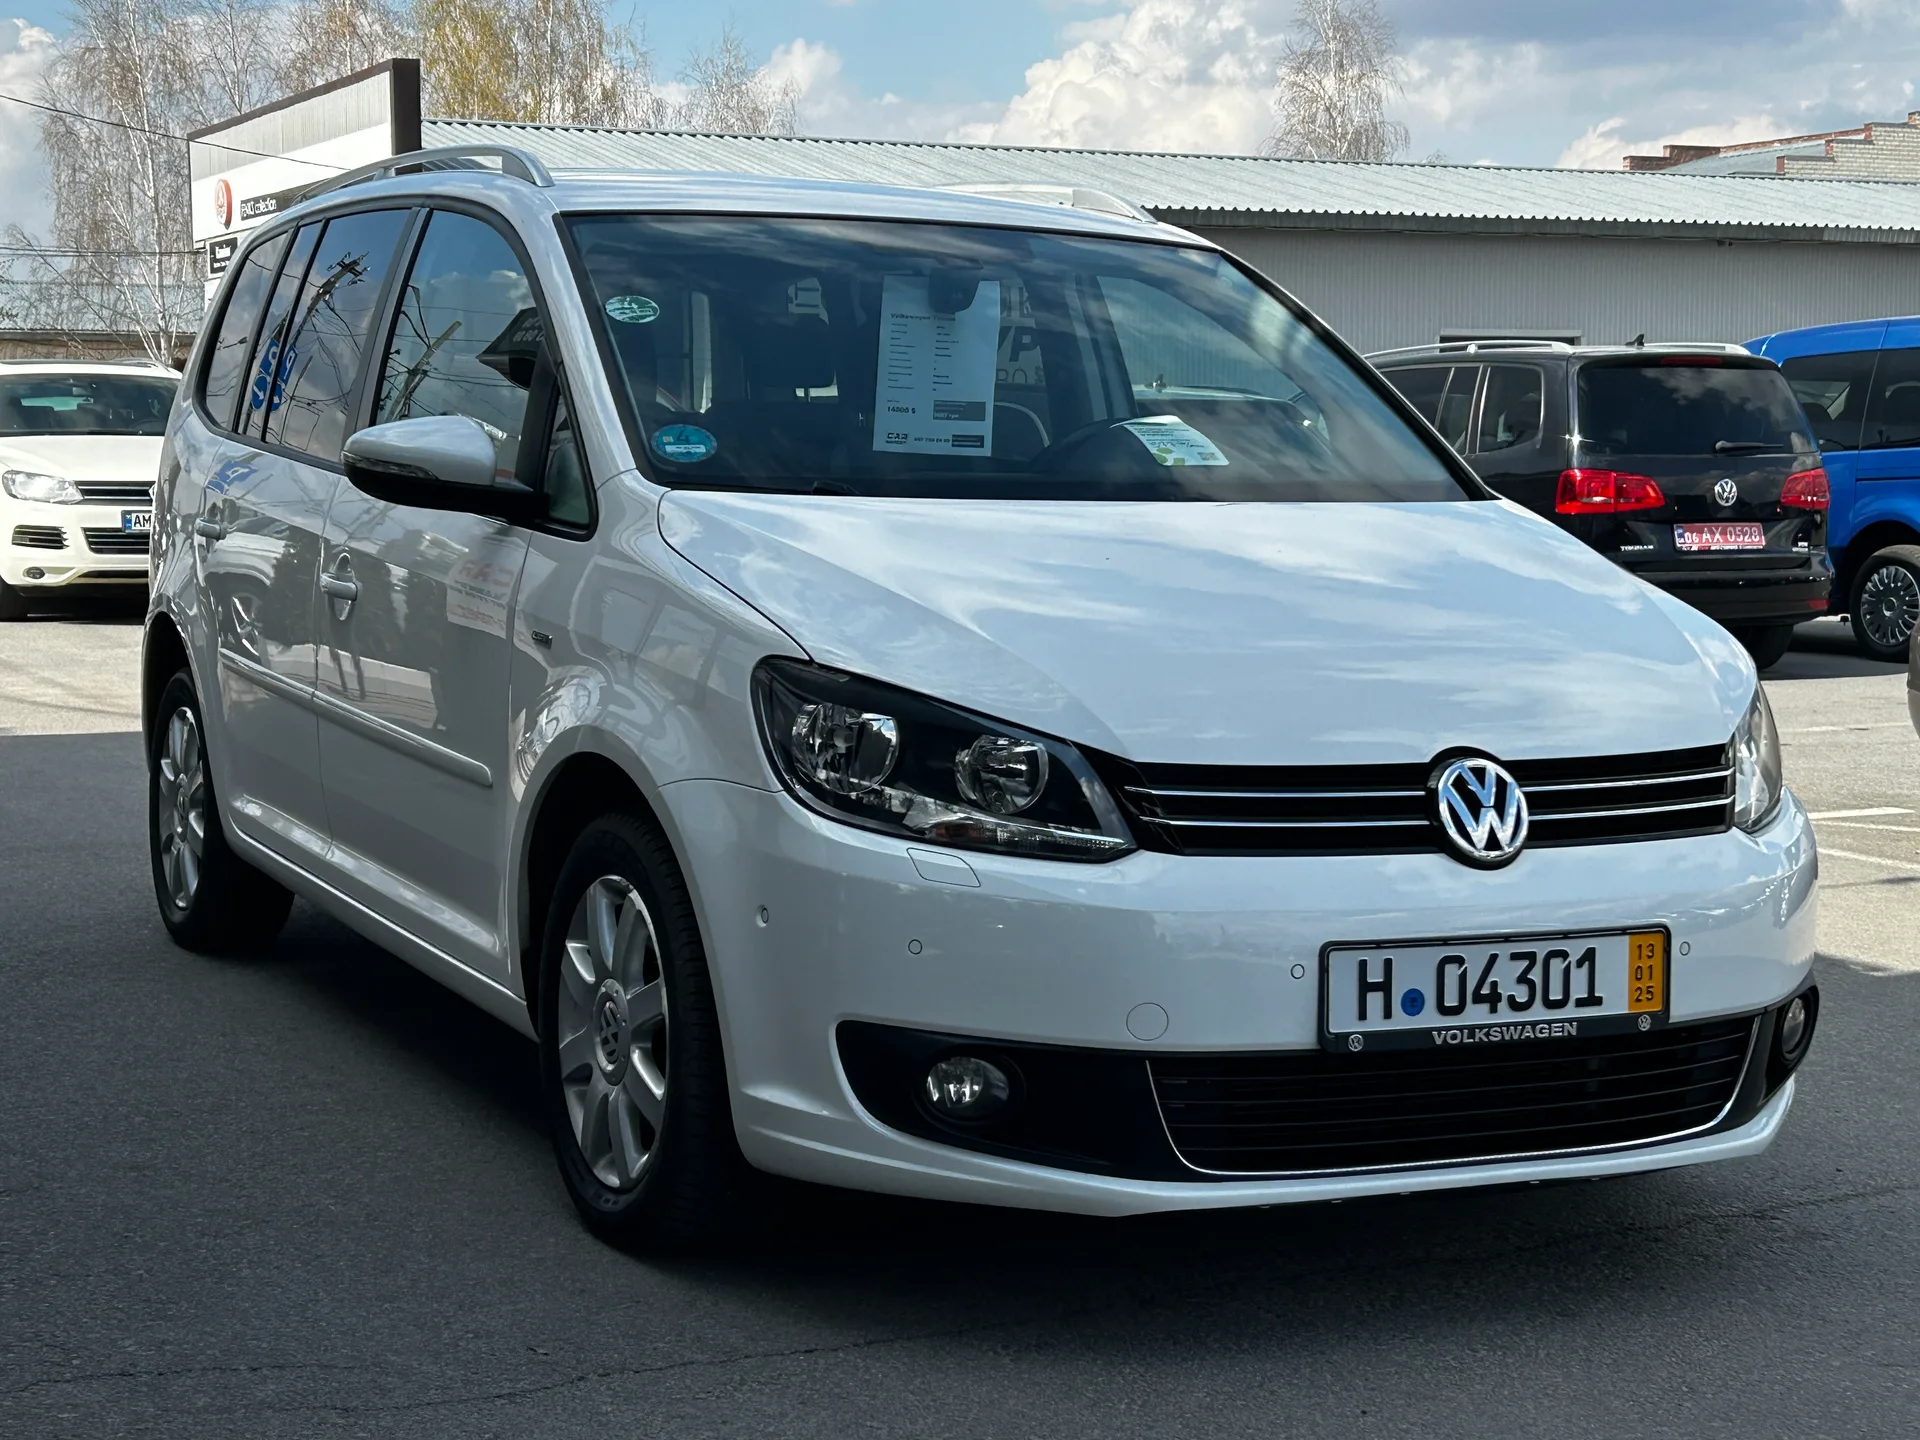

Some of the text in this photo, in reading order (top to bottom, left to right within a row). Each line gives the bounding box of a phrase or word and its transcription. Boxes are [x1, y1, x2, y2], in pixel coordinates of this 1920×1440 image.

[1684, 526, 1760, 544] 06 AX 0528
[1438, 758, 1529, 859] VW
[1636, 943, 1655, 961] 13
[1635, 964, 1653, 981] 01
[1358, 946, 1604, 1021] H 04301
[1634, 985, 1655, 1003] 25
[1432, 1022, 1578, 1045] VOLKSWAGEN
